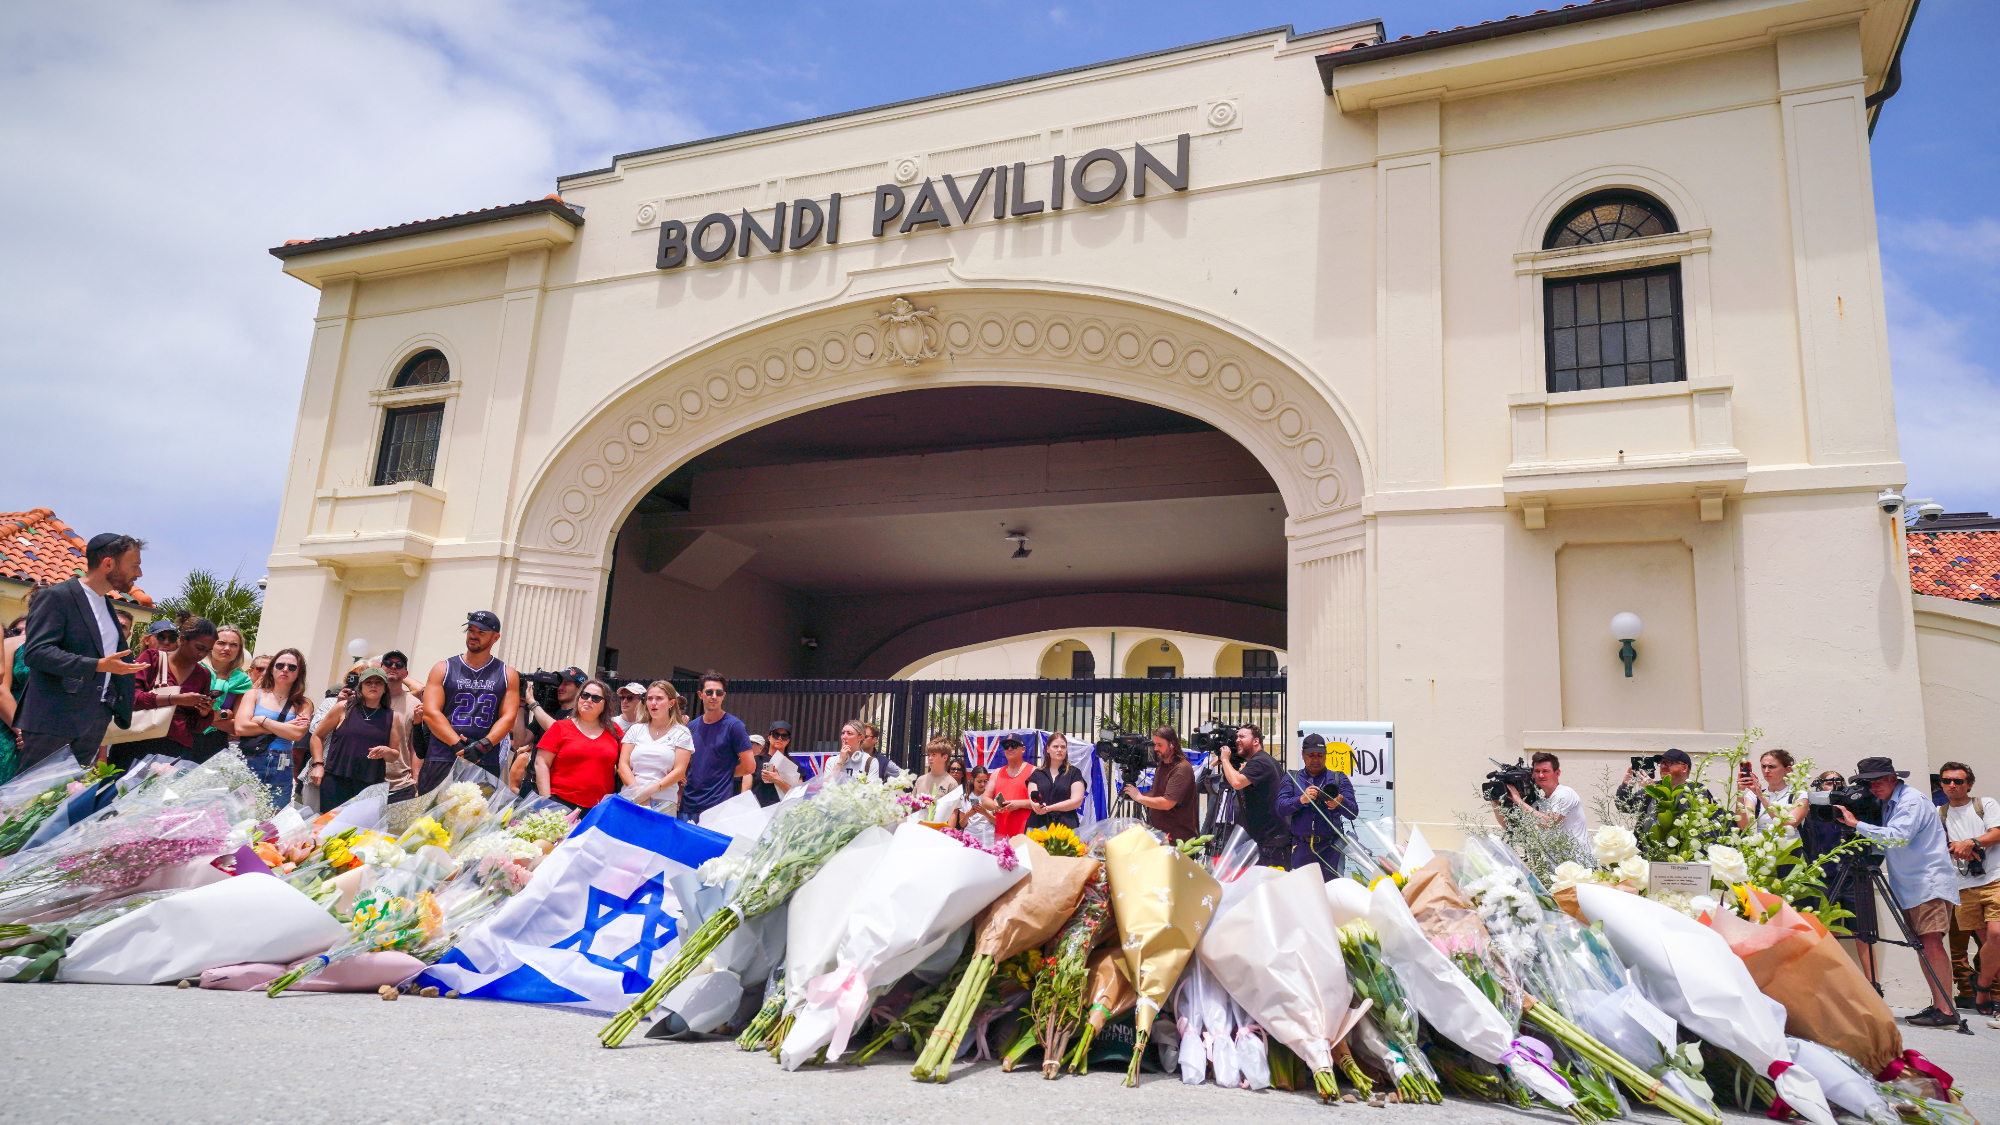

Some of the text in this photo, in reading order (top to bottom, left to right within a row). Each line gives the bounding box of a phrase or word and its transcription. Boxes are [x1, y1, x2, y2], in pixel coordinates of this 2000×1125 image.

[655, 132, 1191, 270] BONDI PAVILION
[456, 678, 496, 691] PSALM
[451, 692, 498, 729] 23
